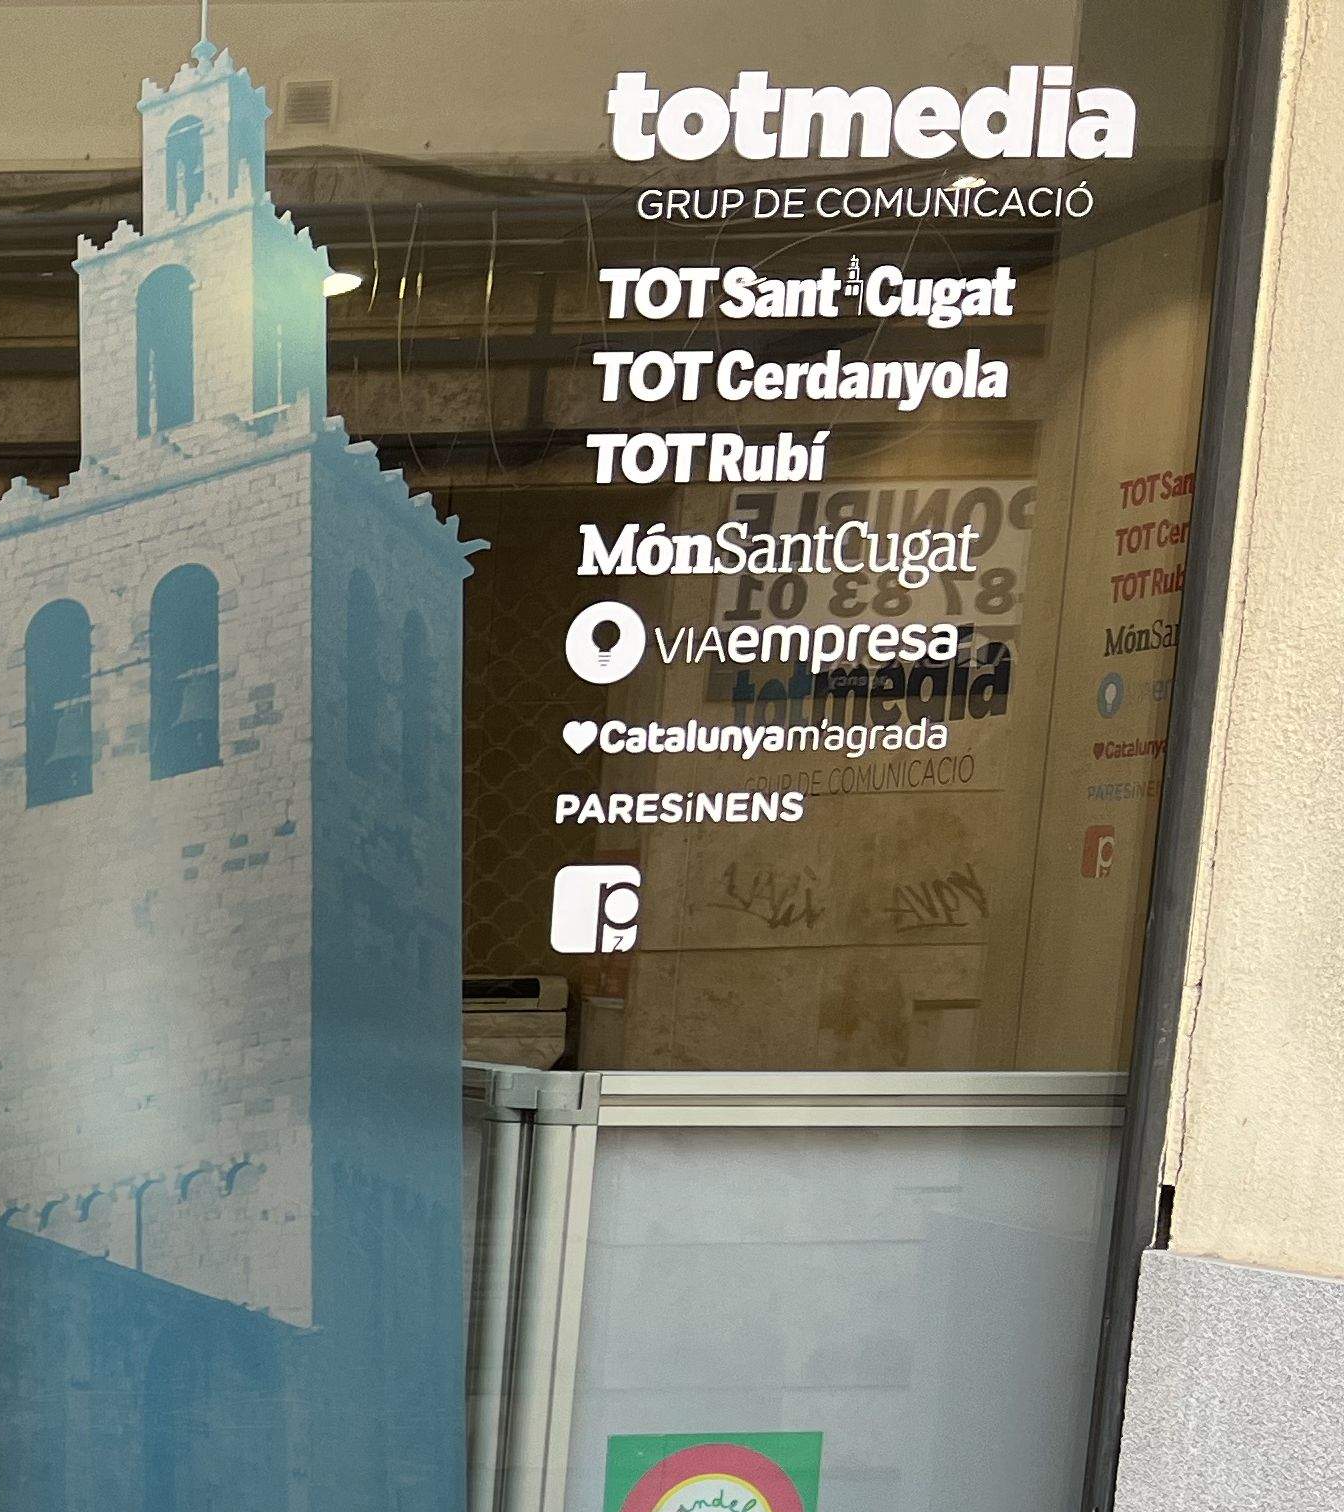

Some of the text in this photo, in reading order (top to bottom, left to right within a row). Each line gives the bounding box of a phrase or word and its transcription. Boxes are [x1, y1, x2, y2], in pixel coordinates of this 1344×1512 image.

[607, 65, 1136, 161] totmedia
[637, 181, 1094, 220] GRUP DE COMUNICACIÓ
[599, 265, 1016, 329] TOT Sant Cugat
[593, 348, 1010, 412] TOT Cerdanyola
[586, 430, 830, 484] TOT Rubí
[577, 520, 979, 587] MónSantCugat
[654, 622, 959, 674] VIAempresa
